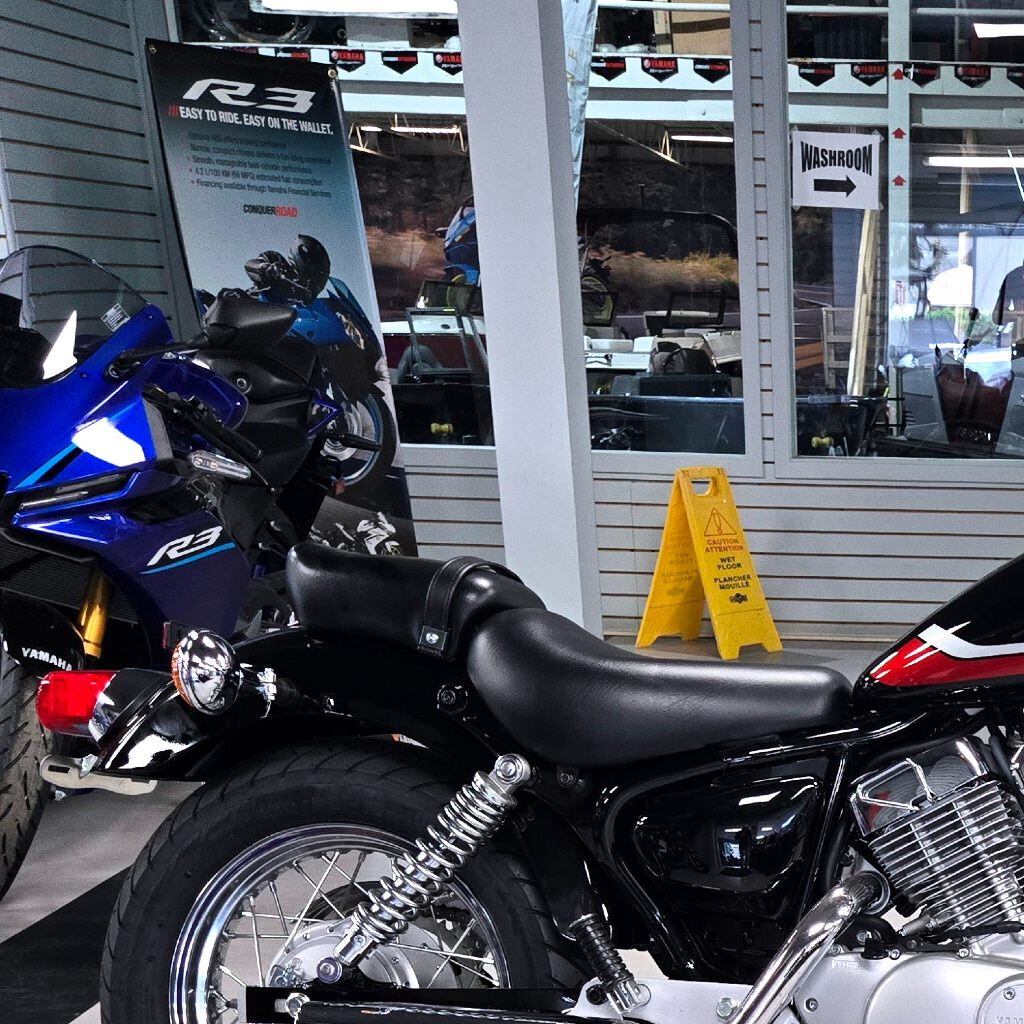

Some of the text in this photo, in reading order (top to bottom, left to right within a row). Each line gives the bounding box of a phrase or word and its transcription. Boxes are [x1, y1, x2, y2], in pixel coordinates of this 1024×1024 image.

[182, 78, 316, 114] R3
[179, 106, 334, 135] EASY TO RIDE. EASY ON THE WALLET.
[800, 140, 872, 176] WASHROOM
[147, 526, 223, 566] R3
[707, 538, 739, 546] CAUTION
[705, 545, 744, 553] ATTENTION
[720, 556, 736, 564] WET
[717, 563, 742, 571] FLOOR
[714, 574, 752, 583] PLANCHER
[719, 581, 751, 590] MOUILLÉ
[22, 647, 72, 671] YAMAHA
